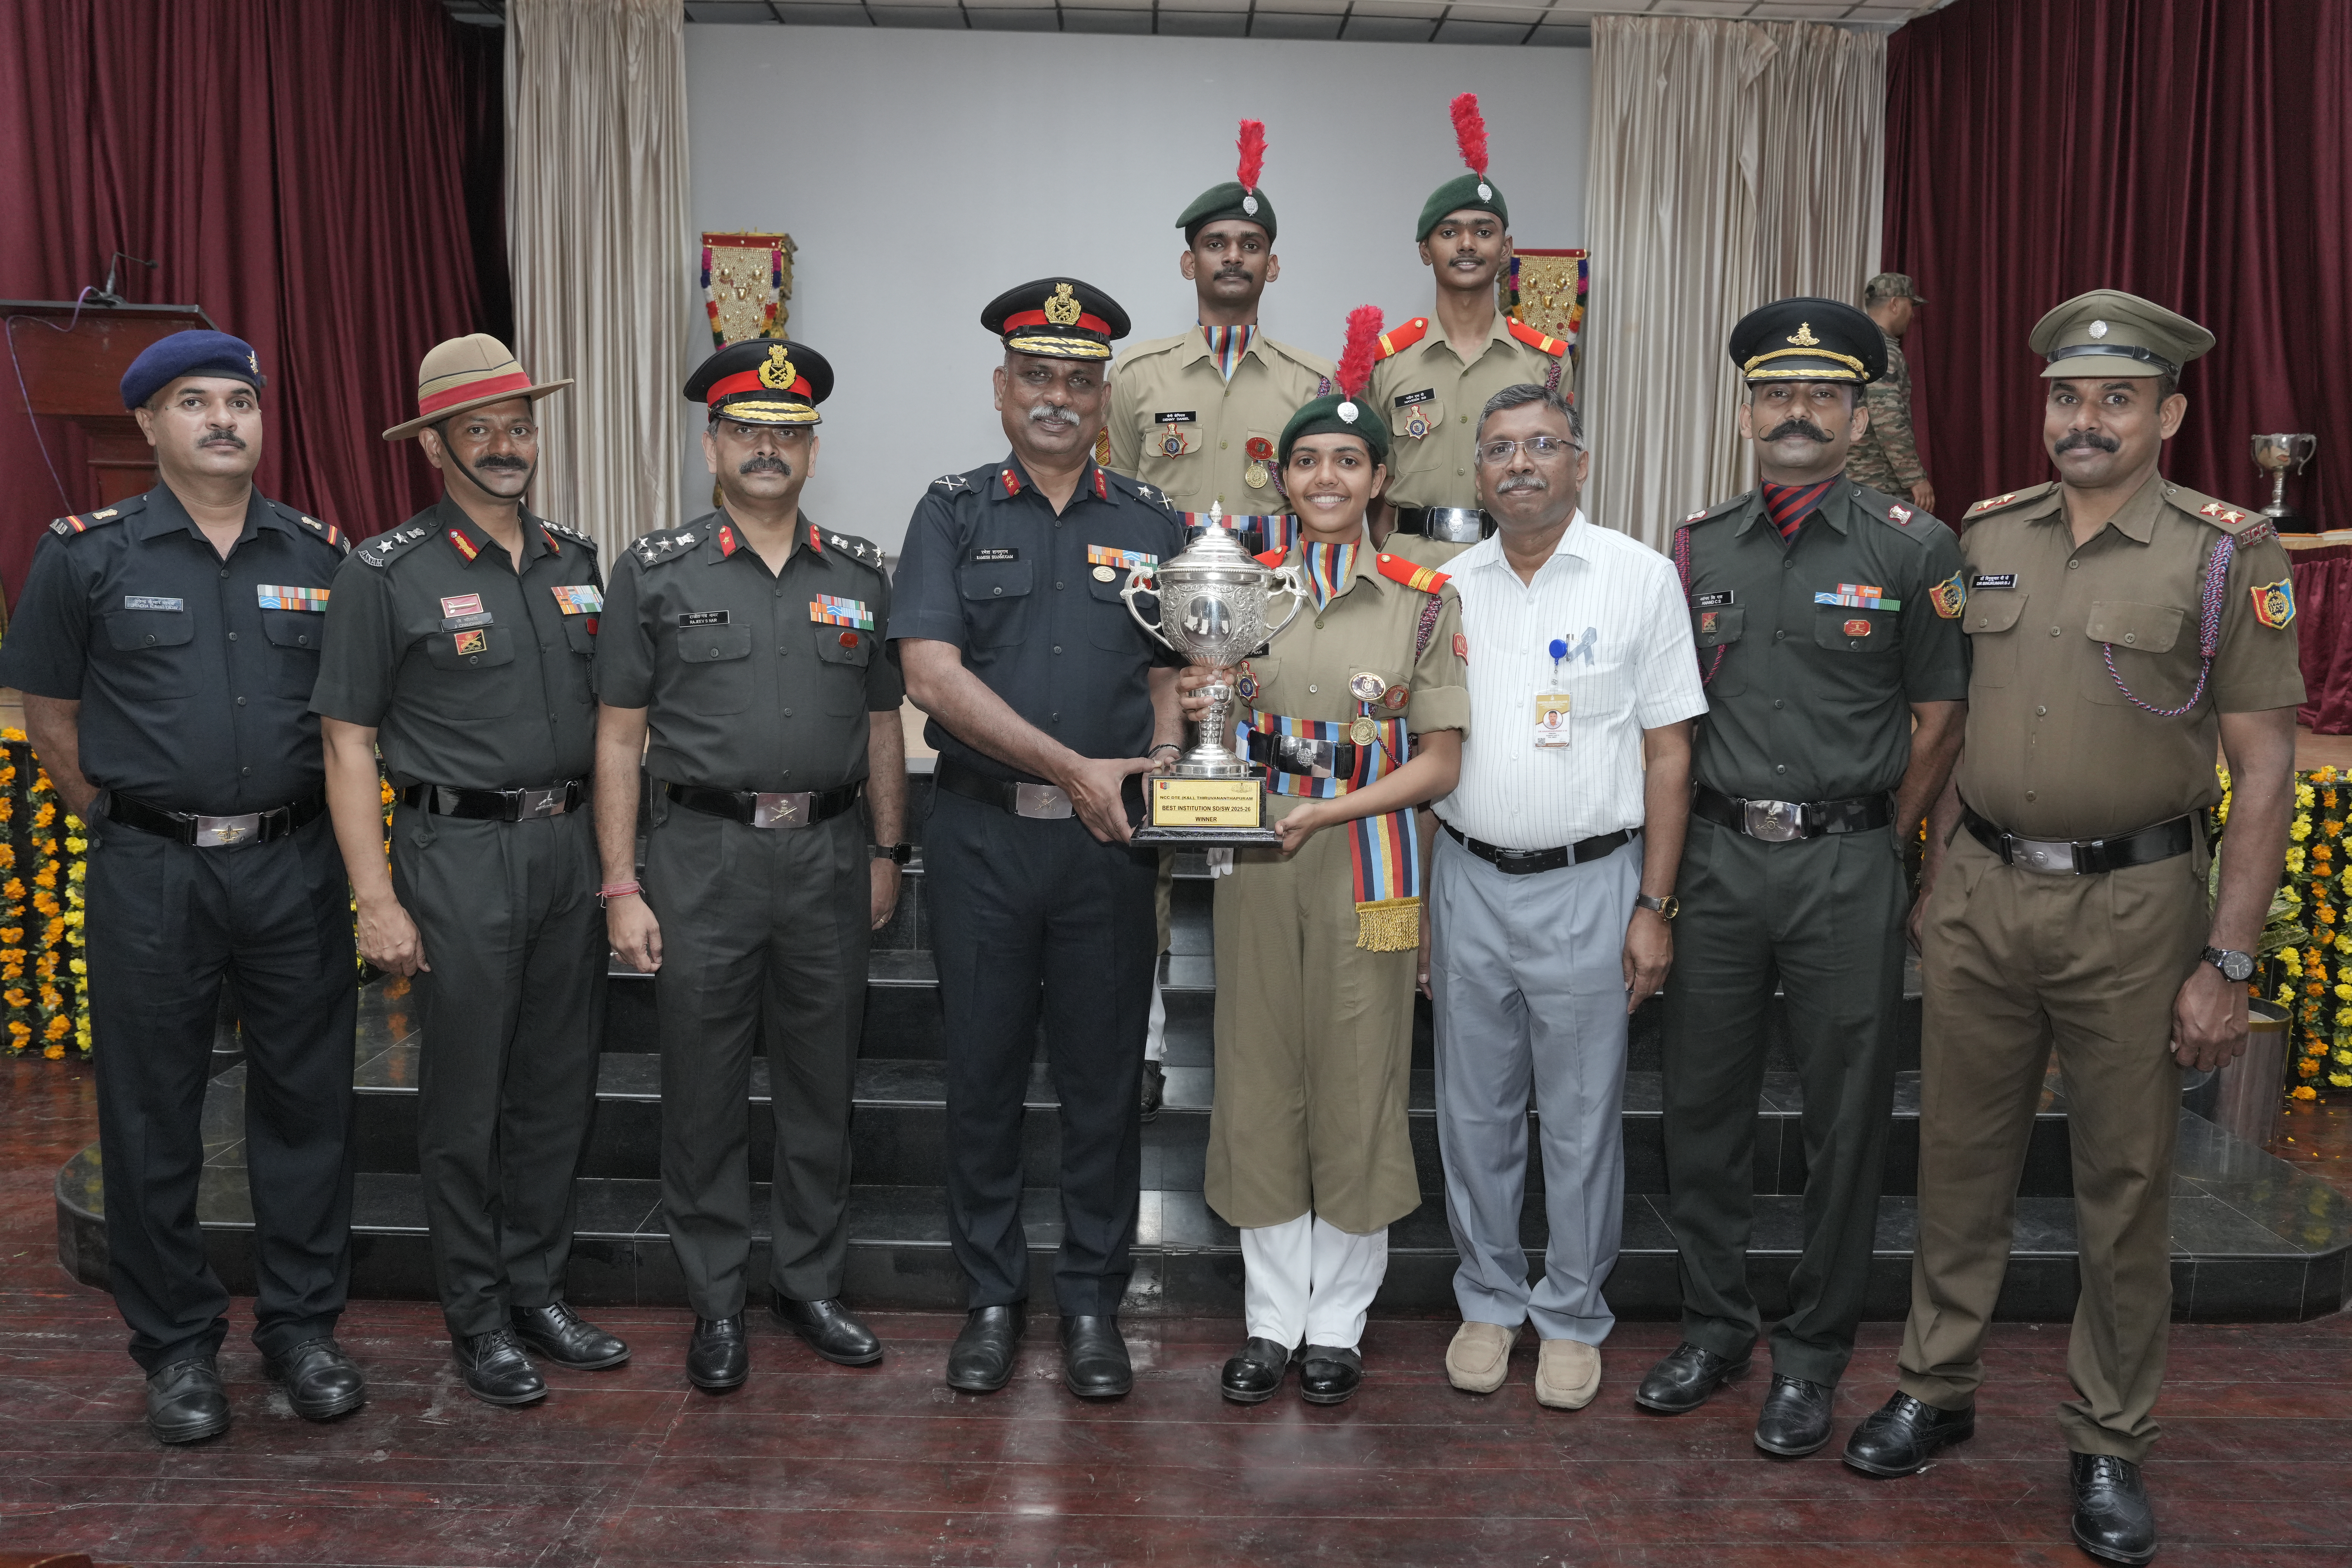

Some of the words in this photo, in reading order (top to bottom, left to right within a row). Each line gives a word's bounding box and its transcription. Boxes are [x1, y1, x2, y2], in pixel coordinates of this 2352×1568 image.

[49, 519, 68, 534] AAD
[2241, 524, 2269, 545] NCC
[358, 550, 384, 567] ASSAM
[2270, 605, 2283, 613] NCC
[1457, 638, 1466, 652] NC
